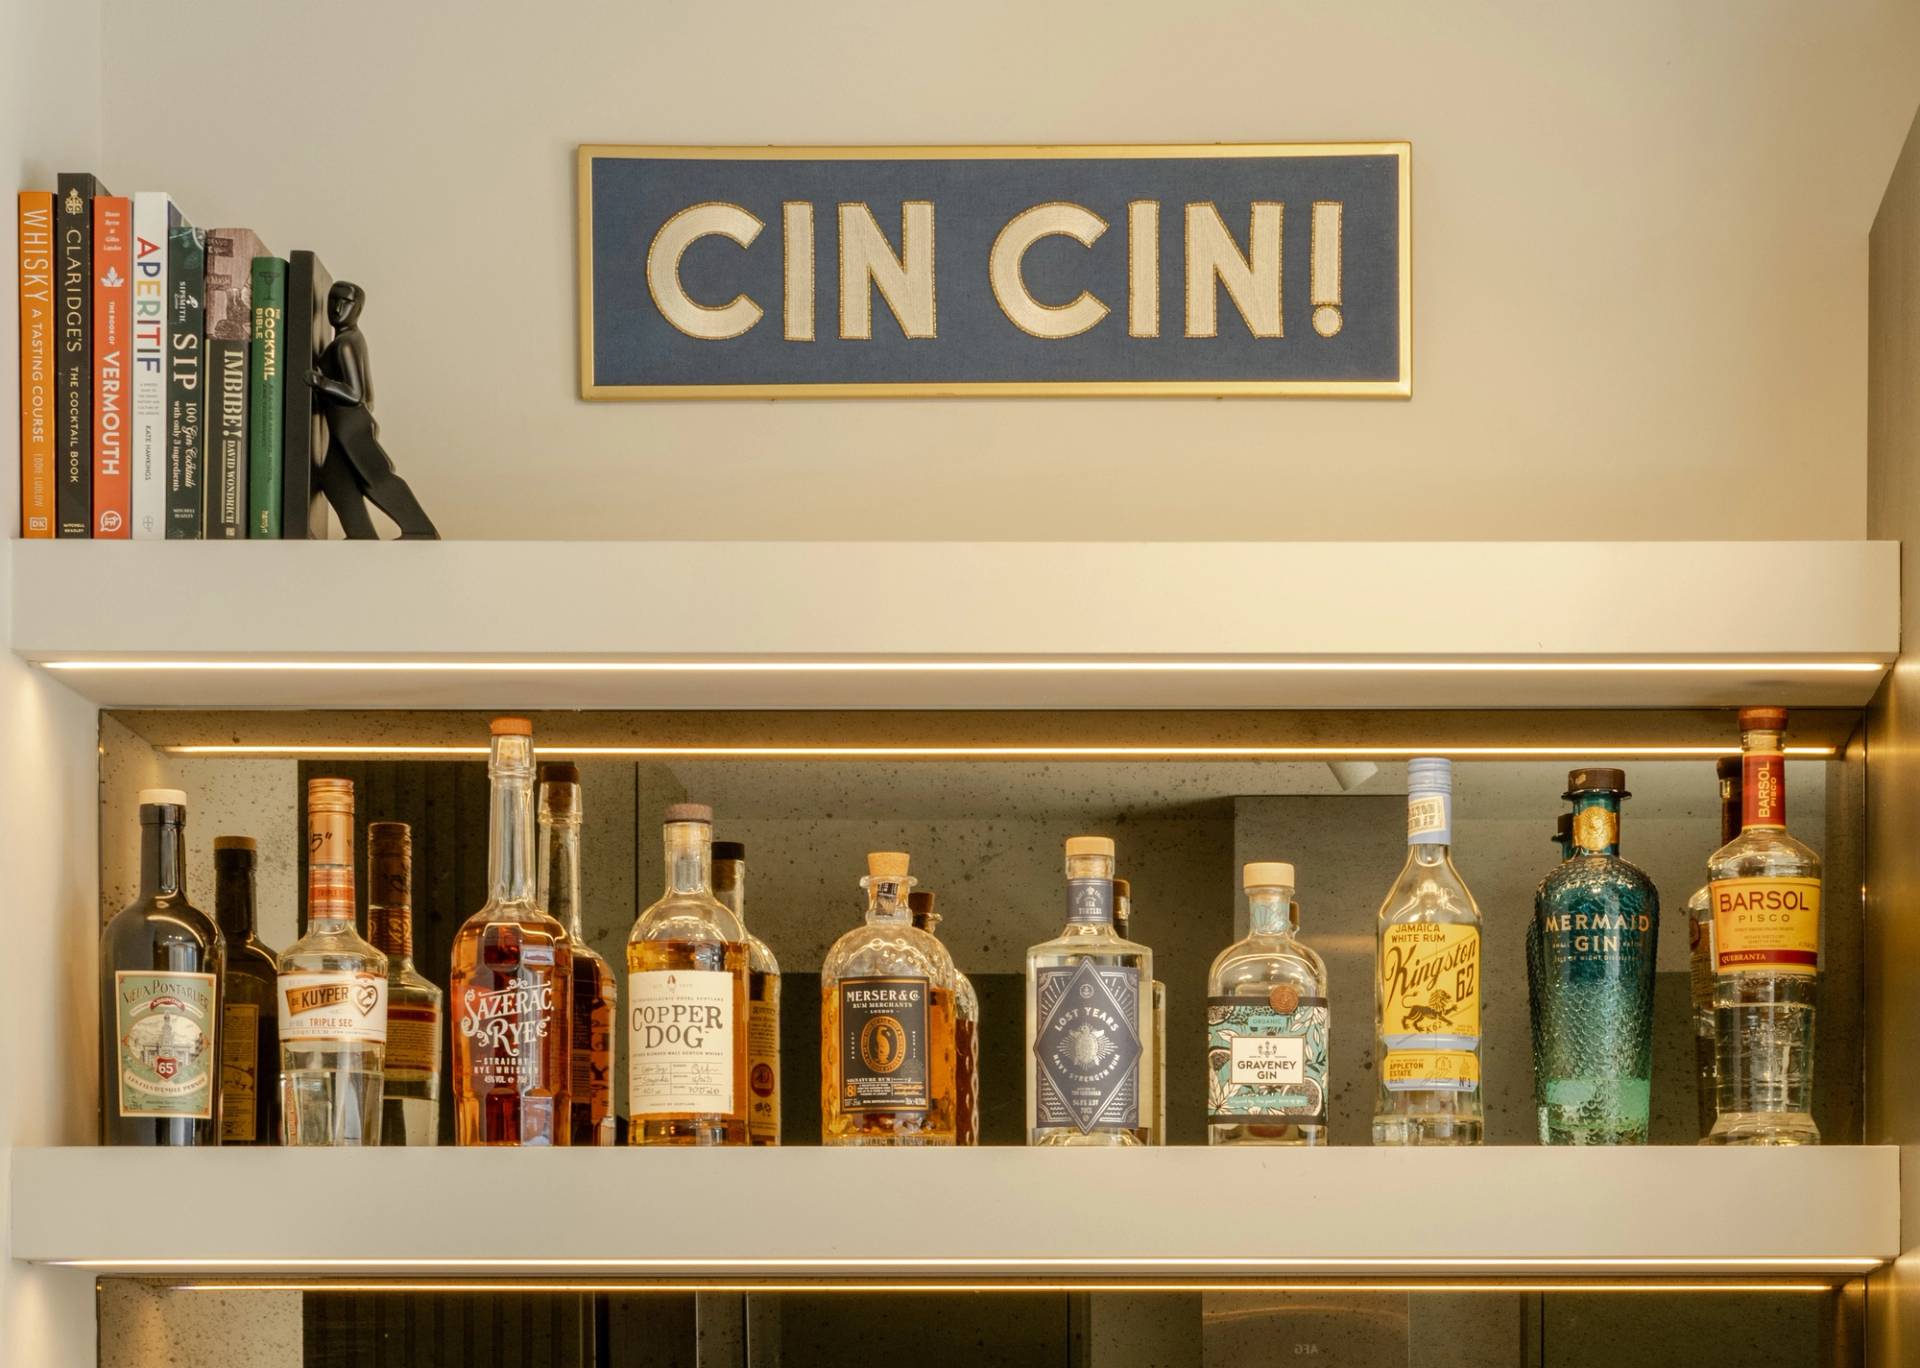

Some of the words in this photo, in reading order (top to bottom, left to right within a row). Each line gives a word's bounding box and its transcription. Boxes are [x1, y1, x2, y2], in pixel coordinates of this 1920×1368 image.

[23, 209, 48, 302] WHISKY
[646, 200, 936, 341] CIN
[989, 199, 1343, 339] CIN!
[64, 229, 82, 352] CLARIDGE'S
[32, 309, 42, 318] A
[137, 237, 160, 373] APERITIF
[255, 307, 263, 339] BIBLE
[32, 323, 43, 380] TASTING
[264, 307, 275, 381] COCKTAIL
[173, 333, 198, 390] SIP
[70, 366, 79, 388] THE
[223, 350, 244, 438] IMBIBE!
[32, 385, 44, 443] COURSE
[70, 392, 79, 447] COCKTAIL
[102, 350, 120, 475] VERMOUTH
[172, 400, 180, 417] with
[186, 402, 197, 422] 100
[172, 419, 181, 438] only
[181, 424, 198, 446] Gin
[225, 440, 236, 468] DAVID
[70, 451, 79, 483] BOOK
[172, 446, 181, 491] ingredients
[184, 447, 198, 488] Cocktails
[225, 470, 236, 524] WONDRICH
[1758, 760, 1770, 817] BARSOL
[1720, 890, 1810, 913] BARSOL
[1395, 923, 1441, 933] JAMAICA
[1545, 914, 1650, 932] MERMAID
[1738, 913, 1791, 923] PISCO
[1392, 934, 1420, 943] WHITE
[1423, 933, 1446, 943] RUM
[1574, 935, 1617, 952] GIN
[1721, 953, 1767, 964] QUEBRANTA
[1385, 938, 1476, 1009] Kingston
[1456, 962, 1474, 1003] 62
[301, 986, 349, 1009] KUYPER
[846, 990, 898, 1003] MERSER
[310, 1018, 336, 1028] TRIPLE
[338, 1018, 353, 1028] SEC
[632, 1004, 724, 1032] COPPER
[1054, 1008, 1079, 1032] LOST
[1084, 1006, 1119, 1032] YEARS
[480, 1016, 550, 1057] RYE
[645, 1024, 704, 1049] DOG
[158, 1063, 175, 1074] 65
[473, 1066, 490, 1074] RYE
[483, 1057, 528, 1065] STRAIGHT
[1237, 1060, 1297, 1070] GRAVENEY
[1390, 1062, 1424, 1070] APPLETON
[1257, 1071, 1277, 1080] GIN
